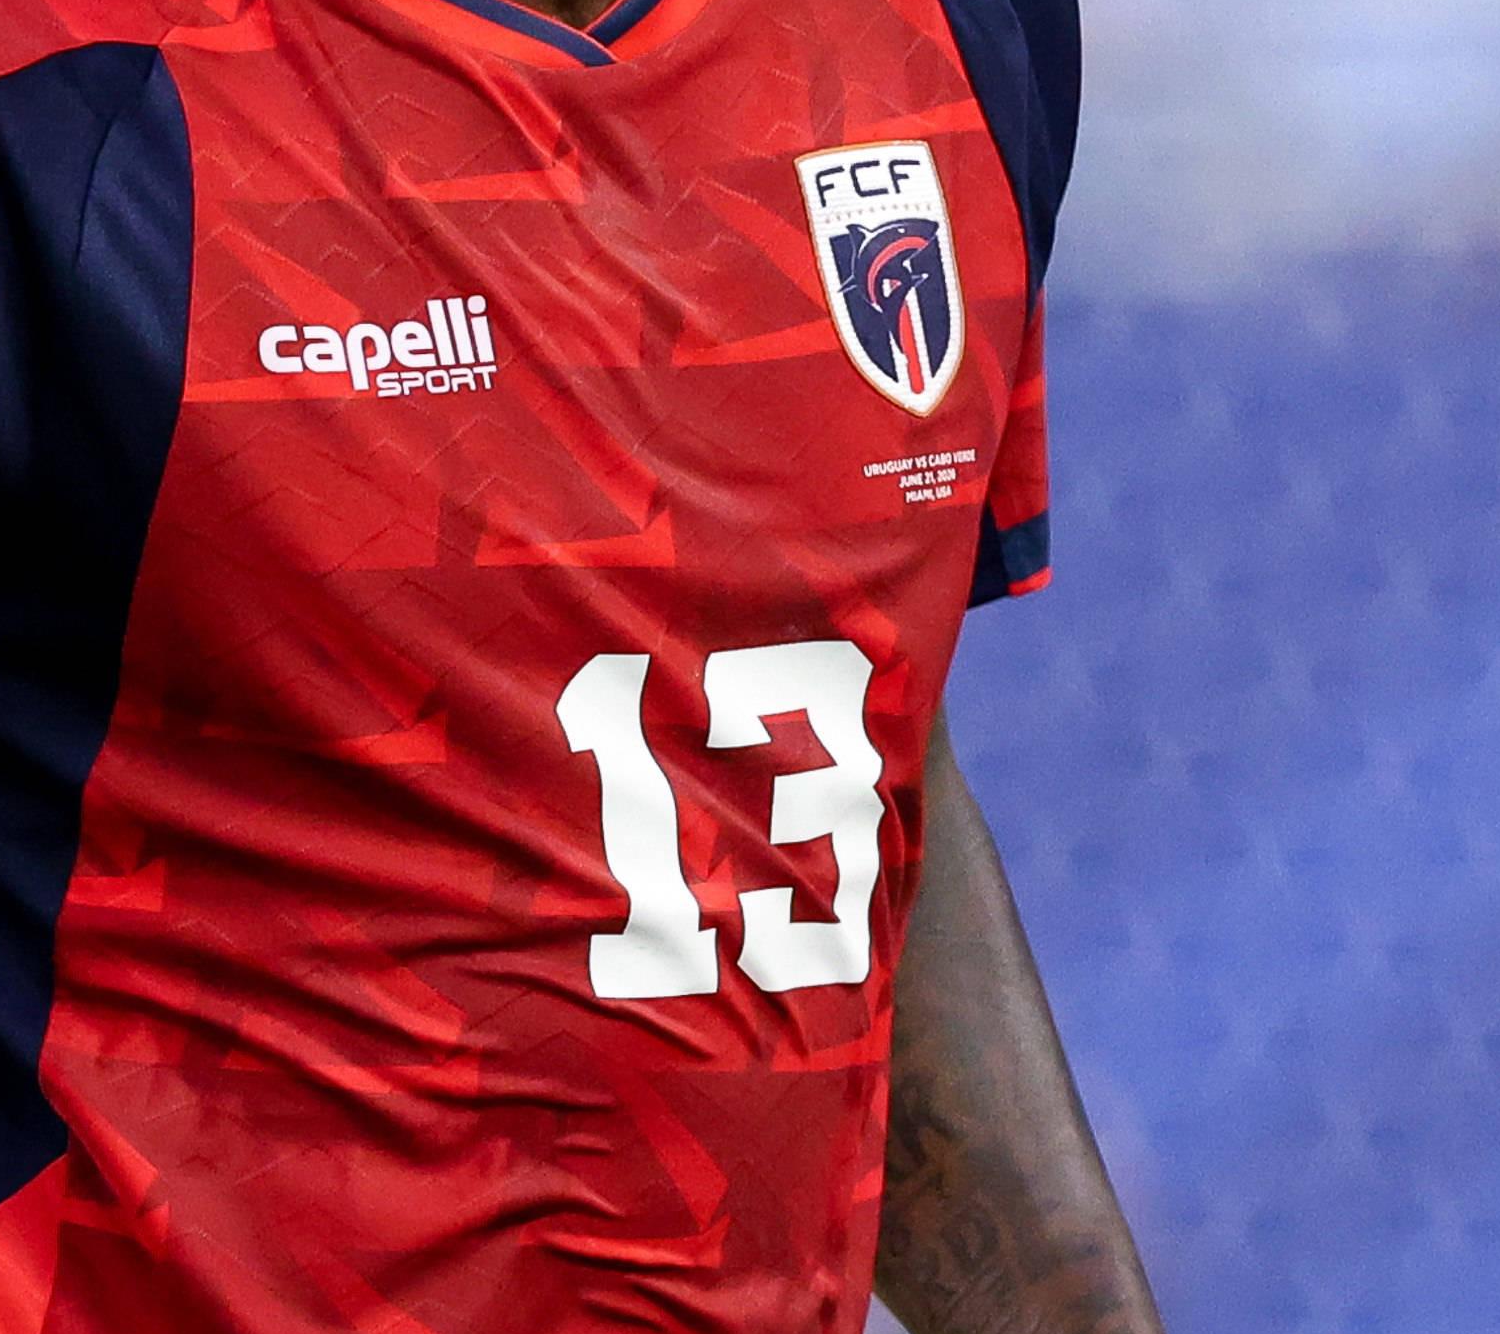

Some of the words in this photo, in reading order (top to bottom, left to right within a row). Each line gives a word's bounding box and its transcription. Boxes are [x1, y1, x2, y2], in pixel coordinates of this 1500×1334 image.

[815, 159, 921, 208] FCF
[258, 294, 496, 391] capelli
[375, 364, 497, 398] SPORT
[863, 457, 914, 478] URUGUAY
[914, 455, 928, 469] VS
[928, 452, 953, 467] CABO
[899, 472, 924, 489] JUNE
[935, 485, 953, 500] USA
[554, 639, 886, 999] 13
